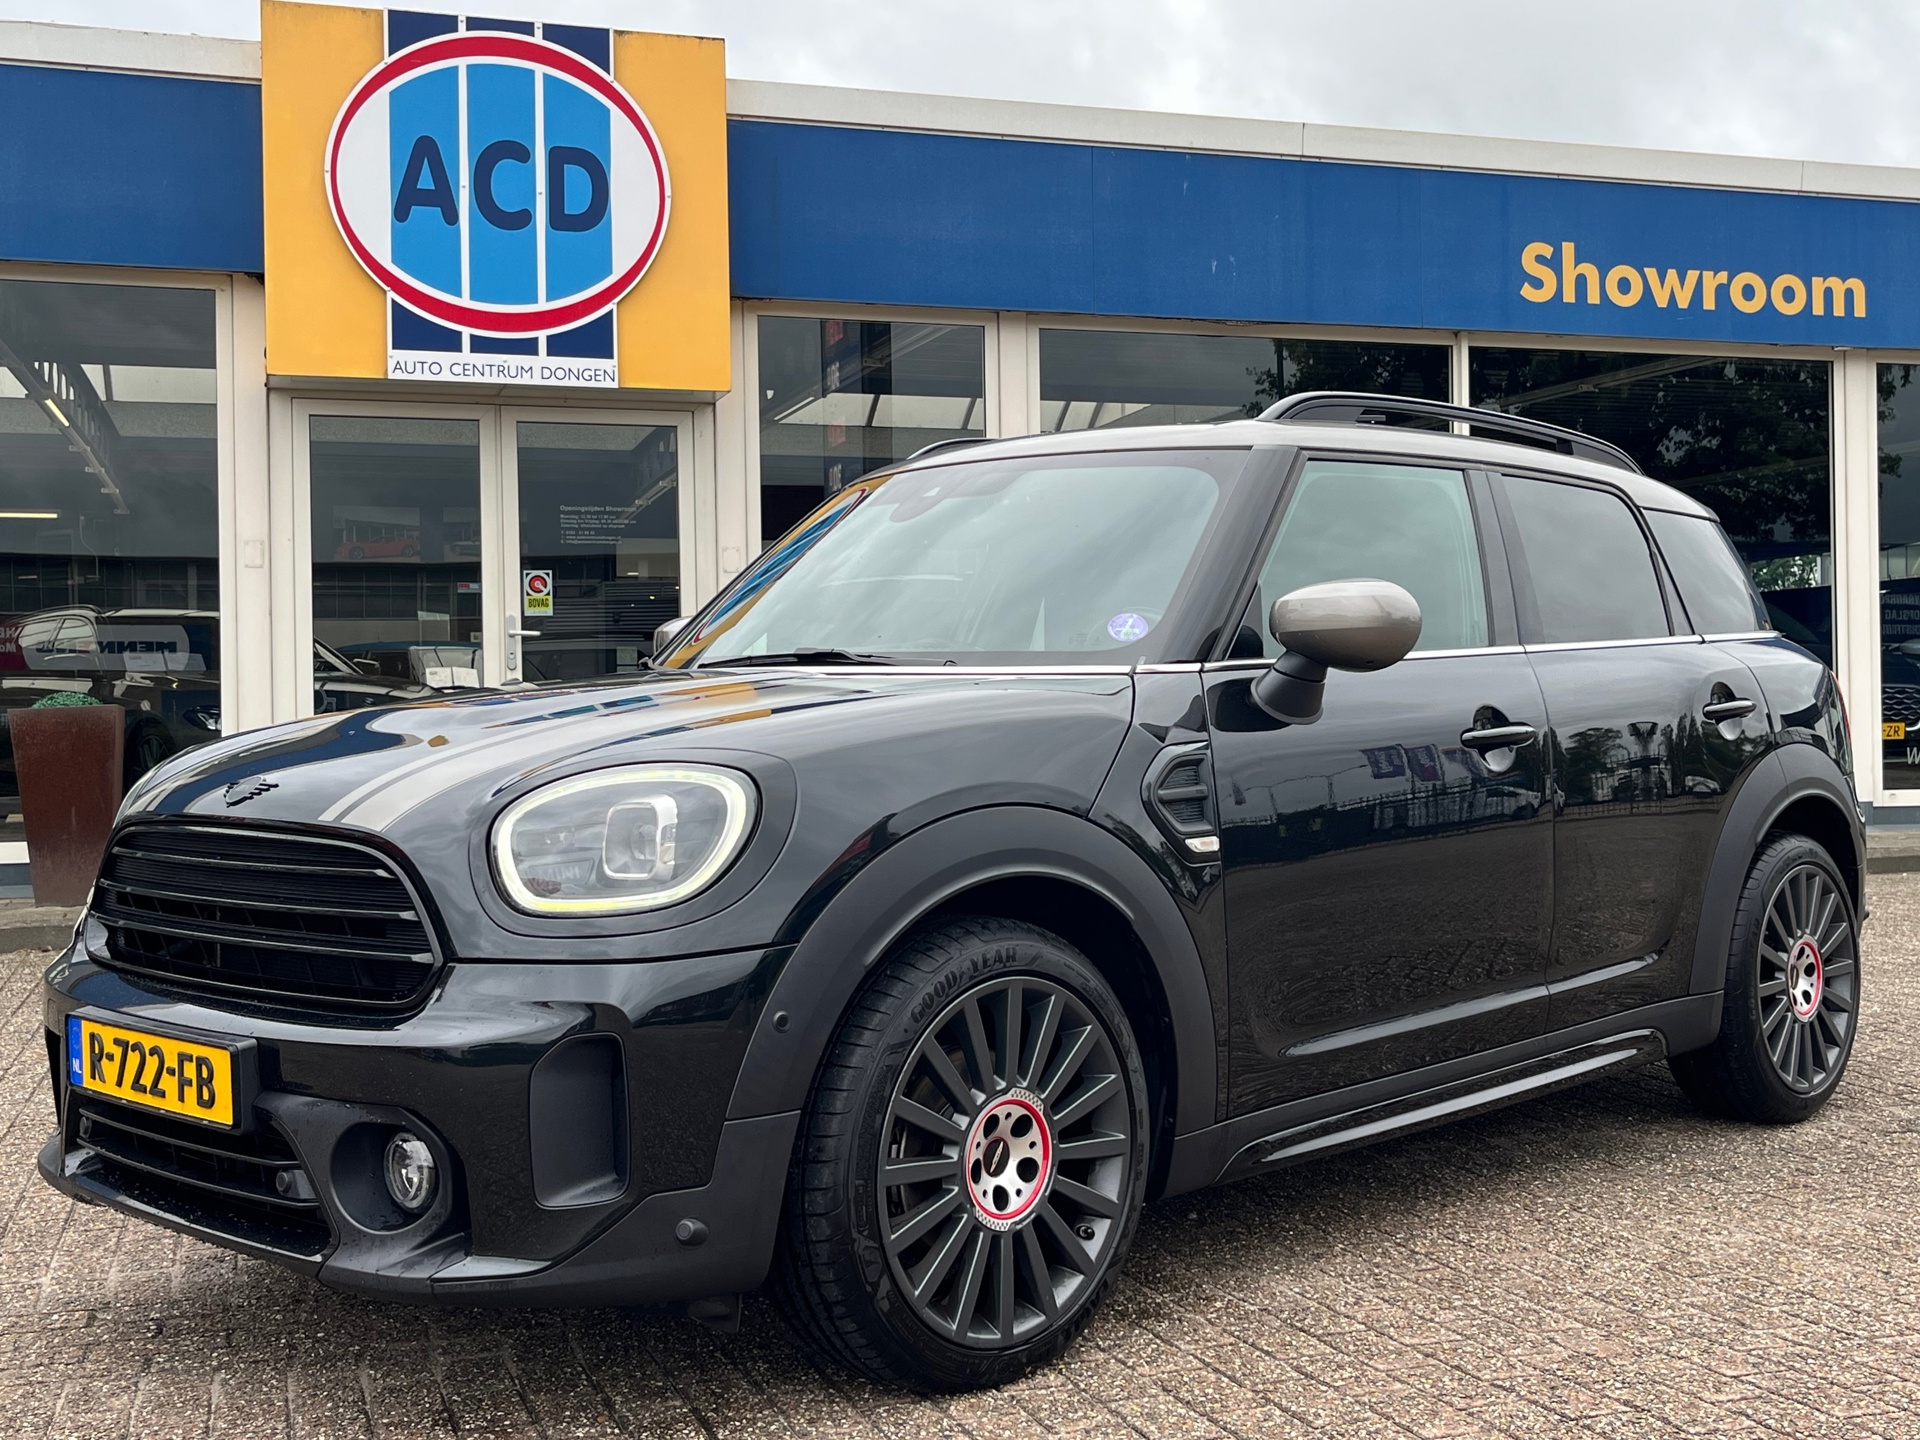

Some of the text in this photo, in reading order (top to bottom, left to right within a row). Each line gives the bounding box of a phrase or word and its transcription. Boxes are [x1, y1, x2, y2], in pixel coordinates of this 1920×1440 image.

[394, 135, 609, 232] ACD
[1520, 241, 1866, 317] Showroom
[392, 360, 615, 383] AUTO CENTRUM DONGEN
[528, 598, 549, 608] BOVAG
[911, 970, 958, 1024] GOOD
[72, 1057, 82, 1074] NL
[89, 1031, 216, 1109] R-722-FB
